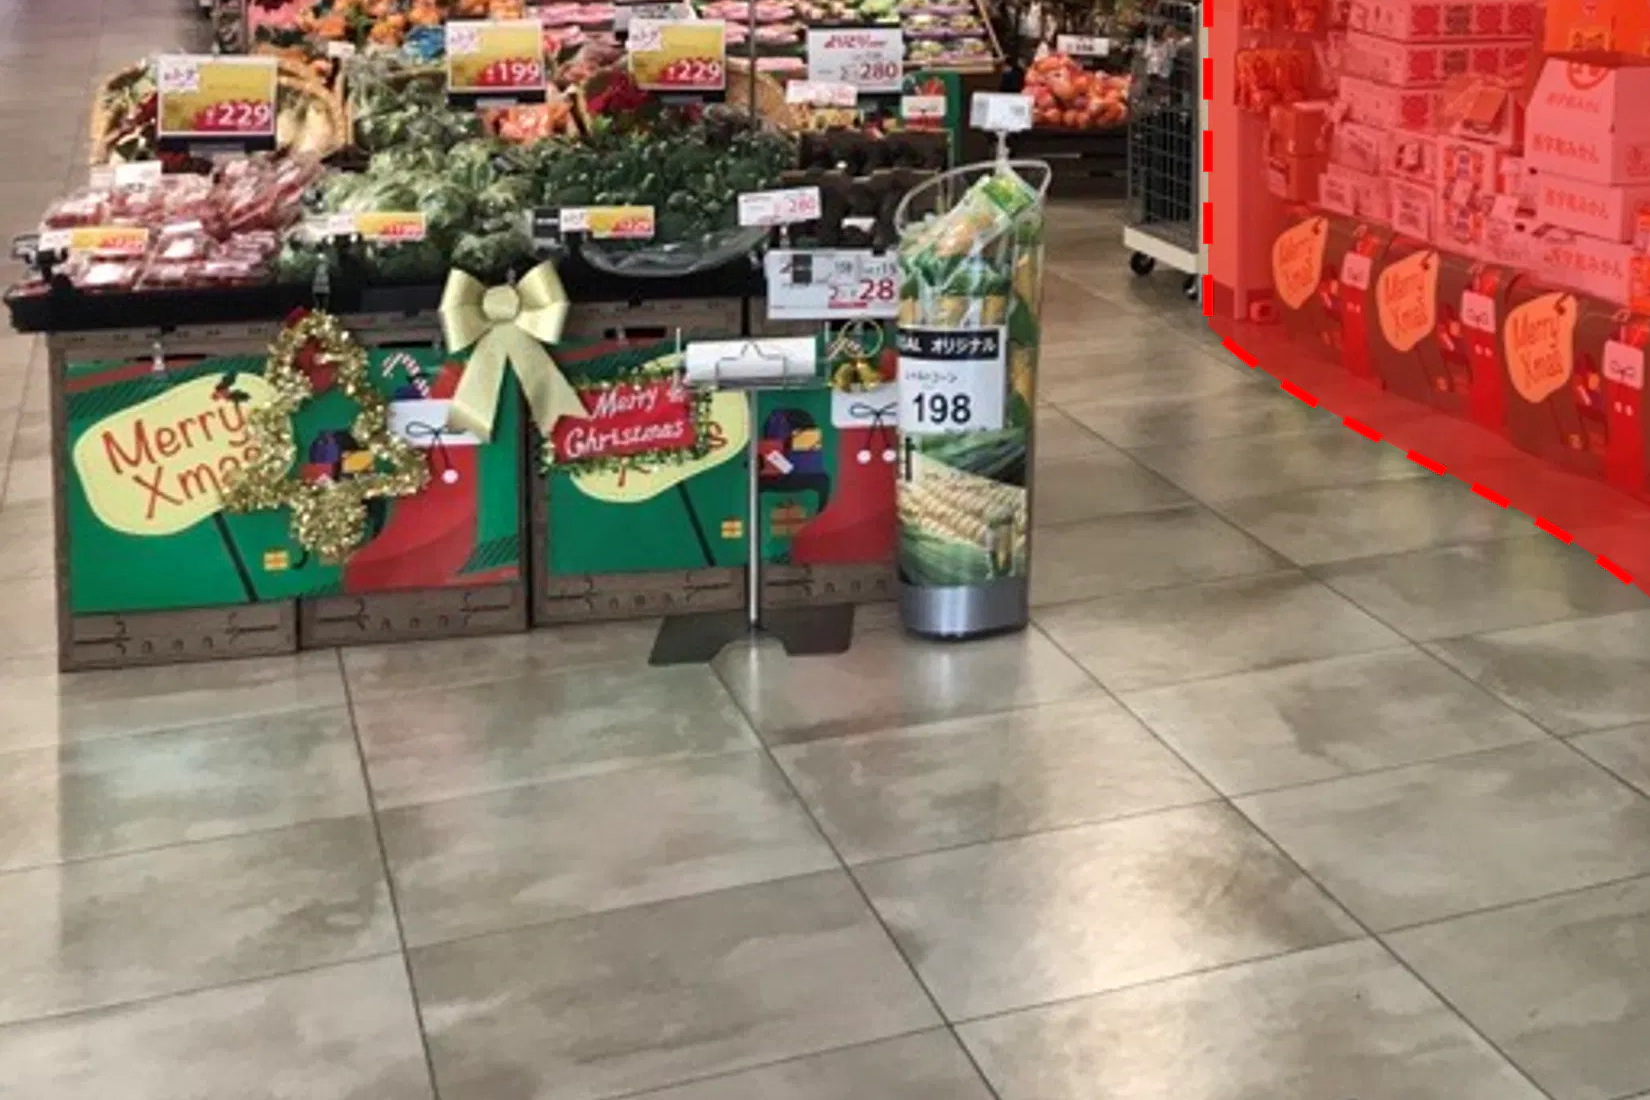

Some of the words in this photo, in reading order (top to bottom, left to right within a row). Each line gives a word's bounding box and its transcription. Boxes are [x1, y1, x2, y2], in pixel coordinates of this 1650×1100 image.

[931, 336, 996, 352] オリジナル
[1513, 311, 1563, 354] Merry
[590, 385, 659, 420] Merry
[912, 391, 972, 425] 198
[102, 400, 246, 475] Merry
[566, 421, 684, 458] Christmas
